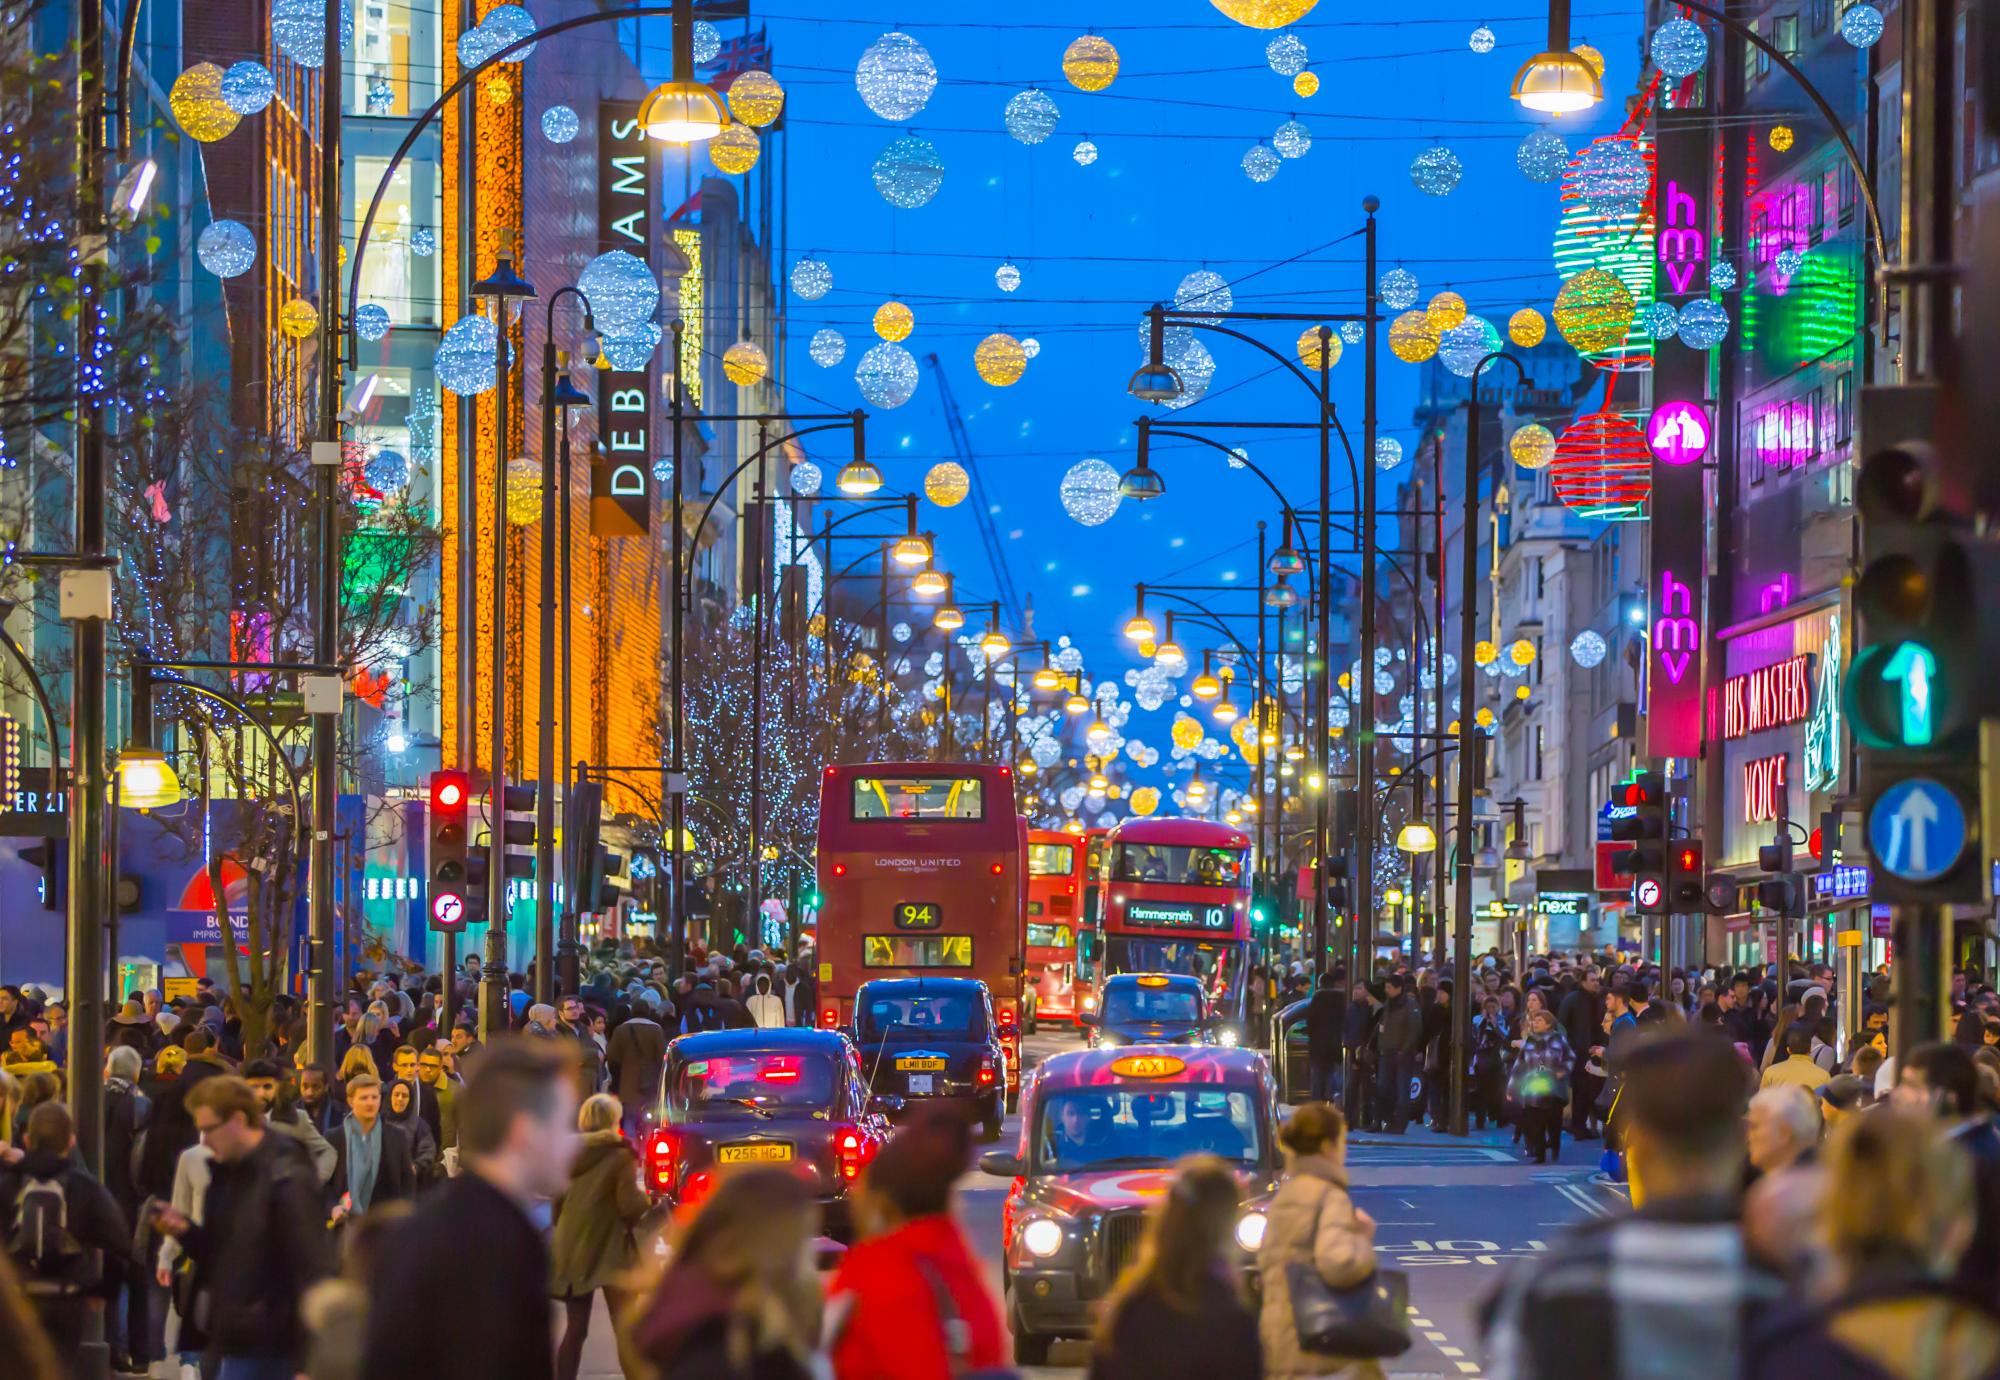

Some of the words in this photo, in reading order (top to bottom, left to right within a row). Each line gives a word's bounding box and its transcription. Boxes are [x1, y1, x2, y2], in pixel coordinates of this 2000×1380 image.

[1658, 180, 1704, 295] hmv
[611, 118, 645, 496] DEBAMS
[1654, 570, 1699, 684] hmv
[1724, 675, 1745, 739] HIS
[46, 792, 64, 812] 21
[874, 858, 916, 867] LONDON
[920, 858, 962, 867] UNITED
[903, 905, 932, 924] 94
[1129, 906, 1193, 922] Hammersmith
[1205, 908, 1224, 927] 10
[1538, 900, 1578, 914] next
[1126, 1060, 1168, 1074] TAXI
[725, 1147, 758, 1160] Y256
